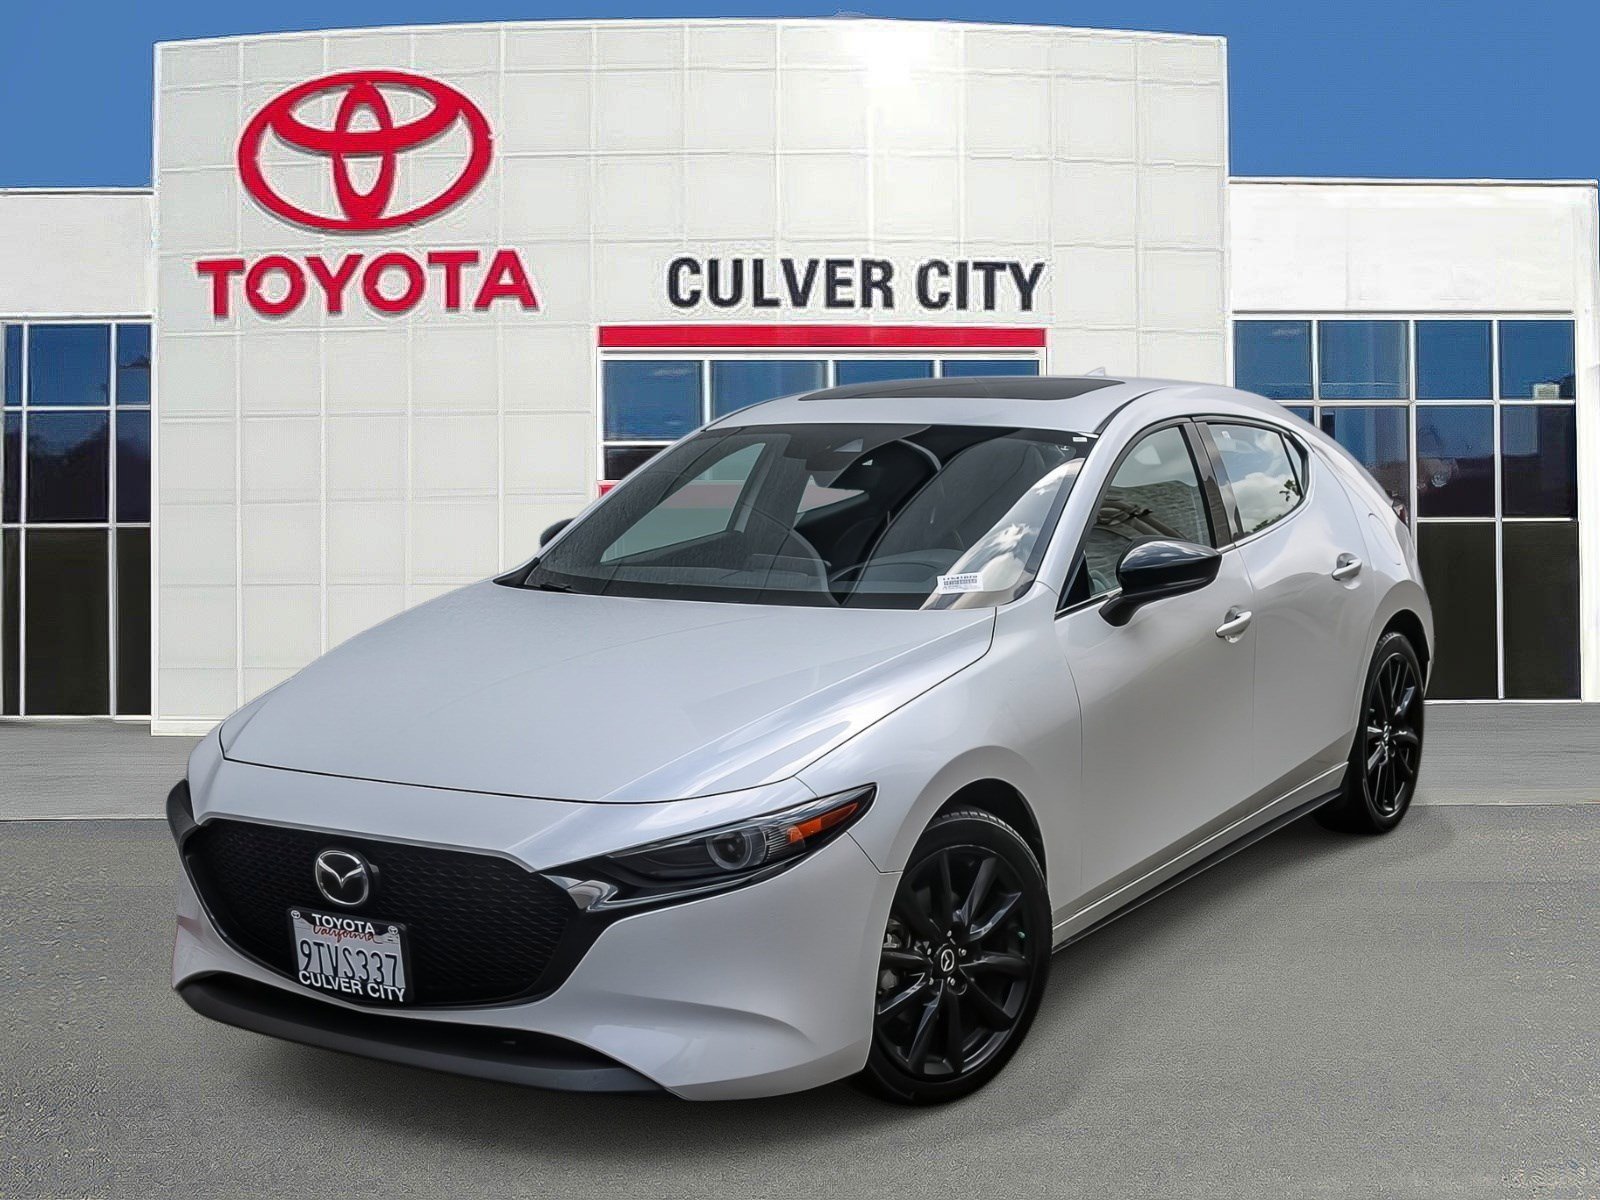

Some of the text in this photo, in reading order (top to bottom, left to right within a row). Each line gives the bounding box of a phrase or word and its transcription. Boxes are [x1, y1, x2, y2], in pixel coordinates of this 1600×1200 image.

[195, 250, 540, 318] TOYOTA
[667, 257, 1046, 311] CULVER CITY
[311, 913, 375, 934] TOYOTA
[299, 970, 405, 1002] CULVER CITY
[300, 939, 398, 987] 9TVS337
